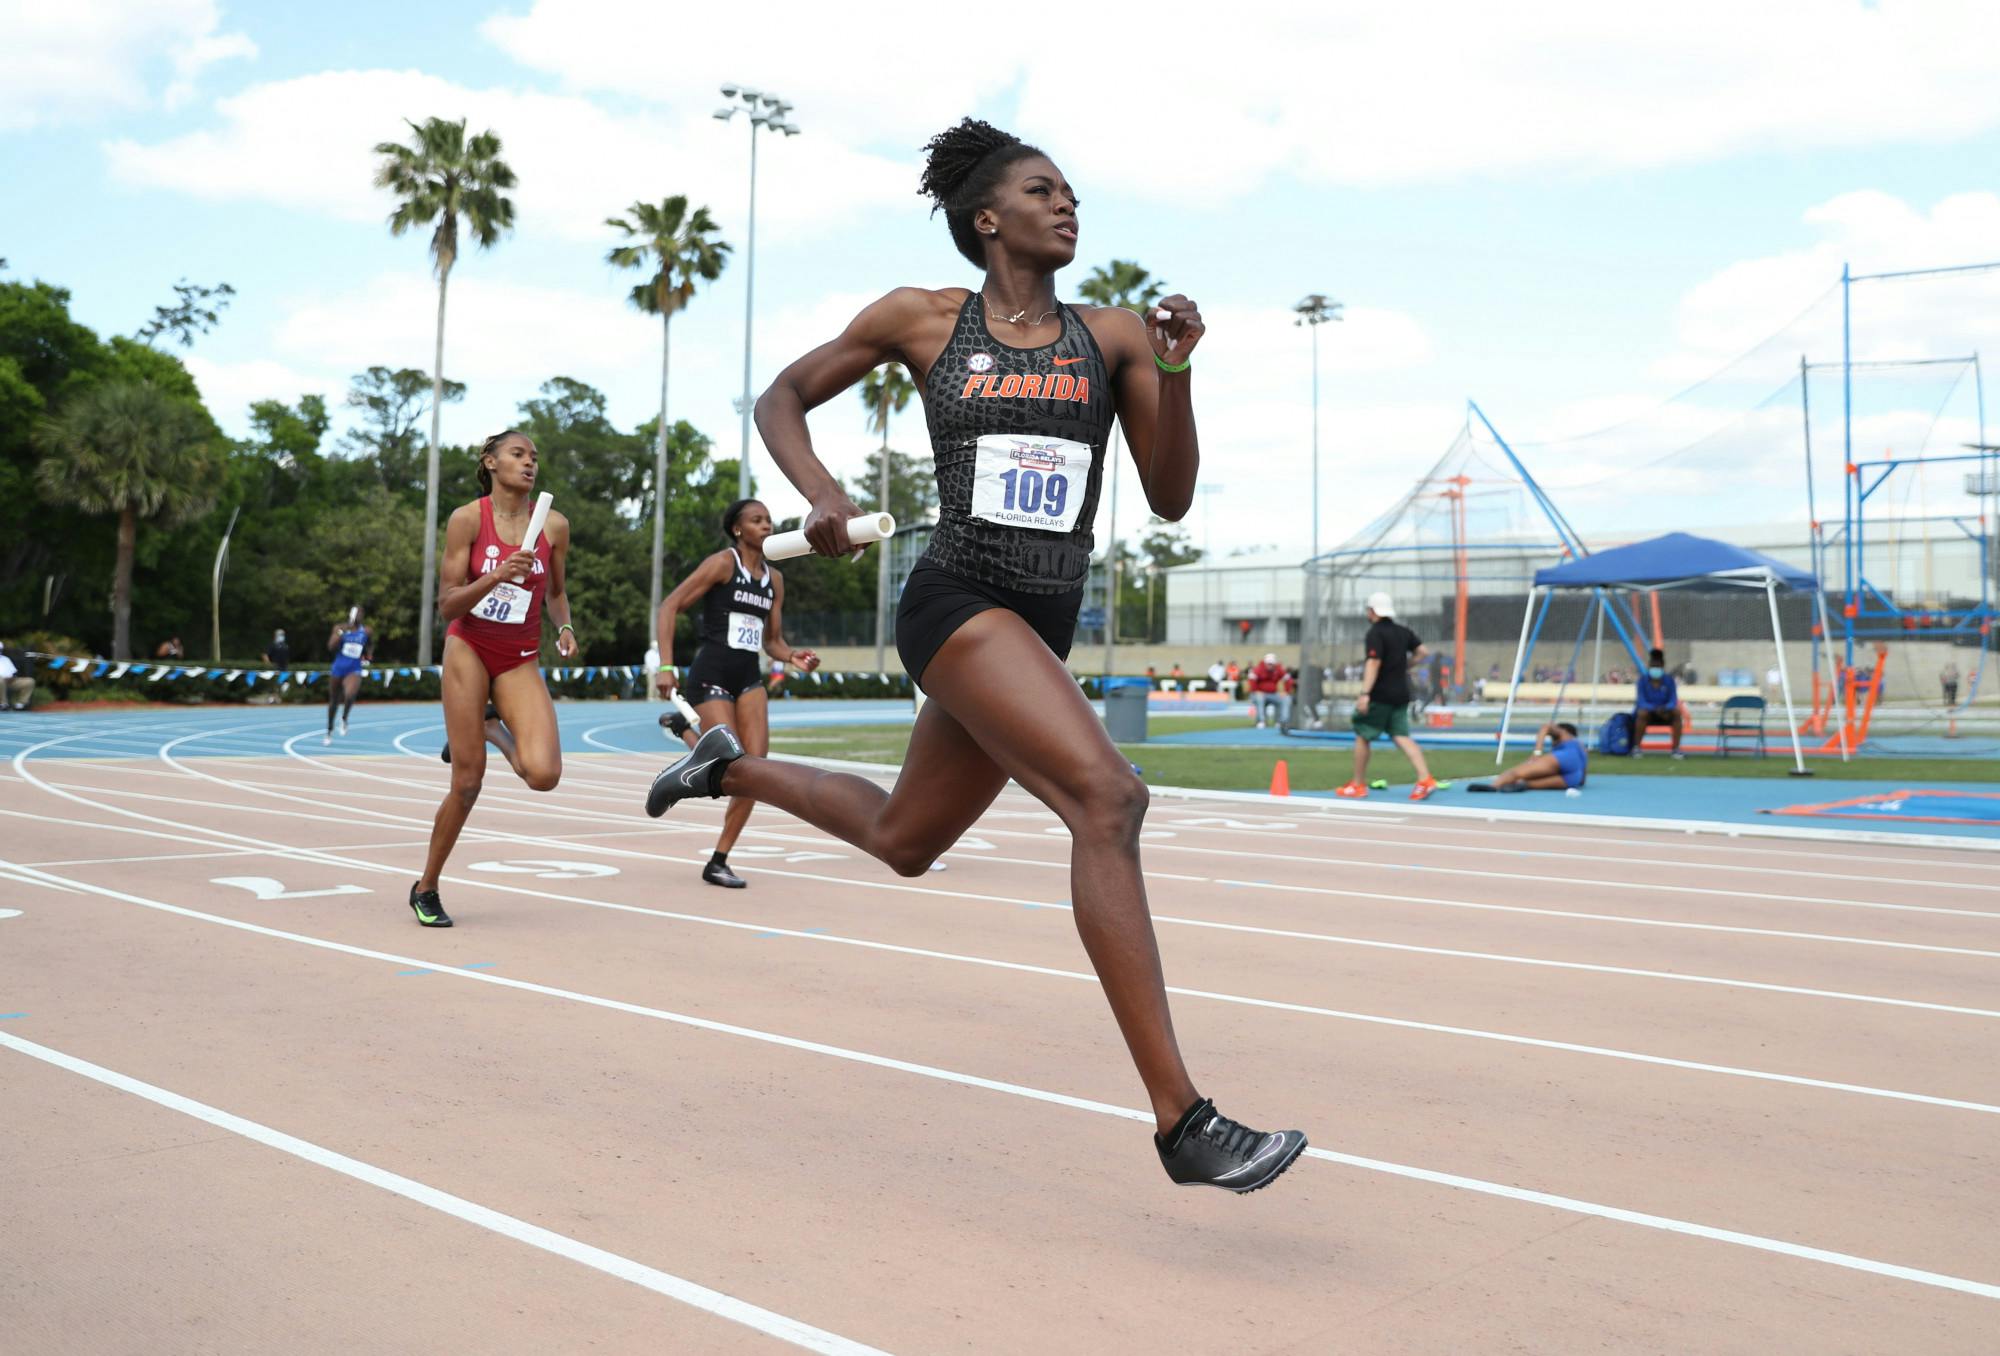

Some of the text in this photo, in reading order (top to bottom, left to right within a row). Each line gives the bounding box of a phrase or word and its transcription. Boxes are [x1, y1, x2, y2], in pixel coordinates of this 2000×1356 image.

[960, 374, 1089, 404] FLORIDA
[999, 468, 1068, 517] 109
[995, 512, 1065, 528] FLORIDA RELAYS
[482, 596, 512, 621] 30
[737, 627, 760, 645] 239
